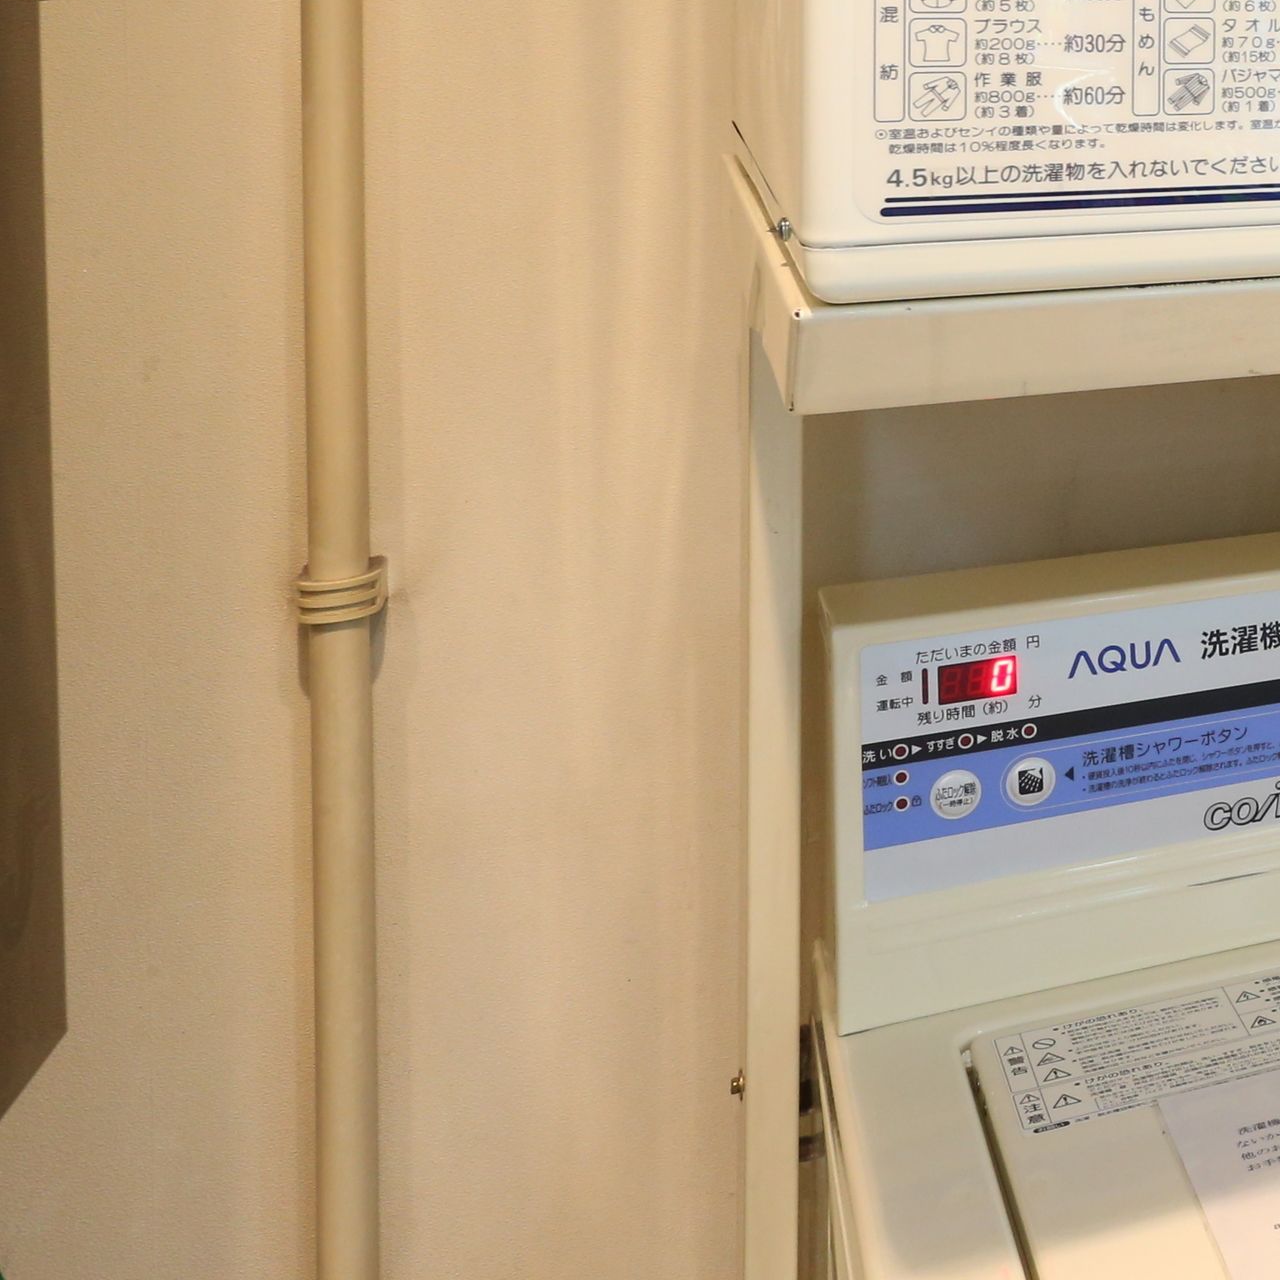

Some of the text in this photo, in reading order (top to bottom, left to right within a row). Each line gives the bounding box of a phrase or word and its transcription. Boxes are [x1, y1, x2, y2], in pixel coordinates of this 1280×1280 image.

[974, 19, 1042, 34] ブラウス
[1063, 33, 1126, 53] 約30分
[974, 72, 1042, 87] 作業服
[1063, 86, 1126, 106] 約60分
[915, 635, 1040, 665] ただいまの金額 円
[1067, 637, 1181, 680] AQUA
[990, 658, 1013, 692] 0
[876, 696, 914, 712] 運転中
[917, 694, 1042, 726] 残り時間(約) 分
[862, 727, 1019, 762] 洗い すすぎ 脱水
[1082, 726, 1249, 768] 洗濯槽シャワーボタン
